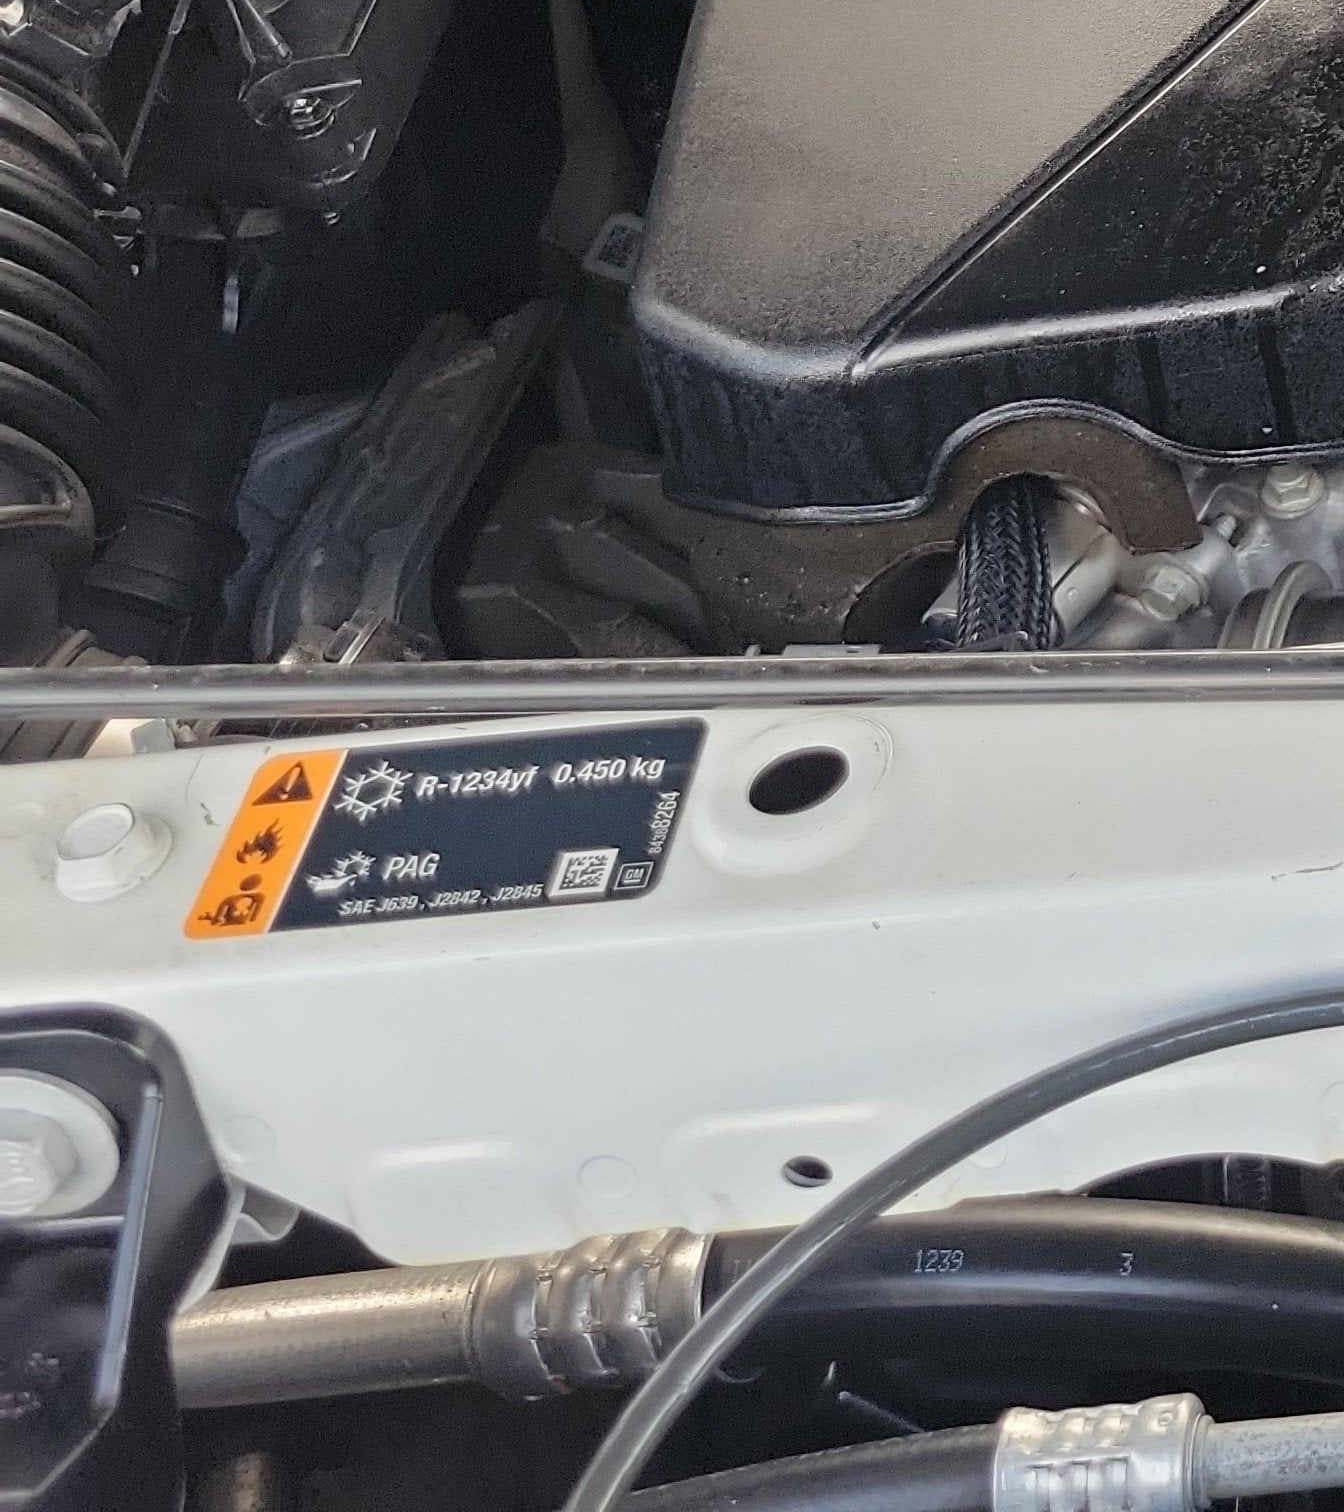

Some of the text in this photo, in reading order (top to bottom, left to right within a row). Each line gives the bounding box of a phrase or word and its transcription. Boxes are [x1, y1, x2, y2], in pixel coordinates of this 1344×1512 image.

[415, 756, 666, 800] R-1234yf 0.450 kg
[382, 854, 441, 881] PAG
[338, 899, 374, 916] SAE
[492, 883, 545, 901] J2845
[912, 1248, 1135, 1276] 1239 3
